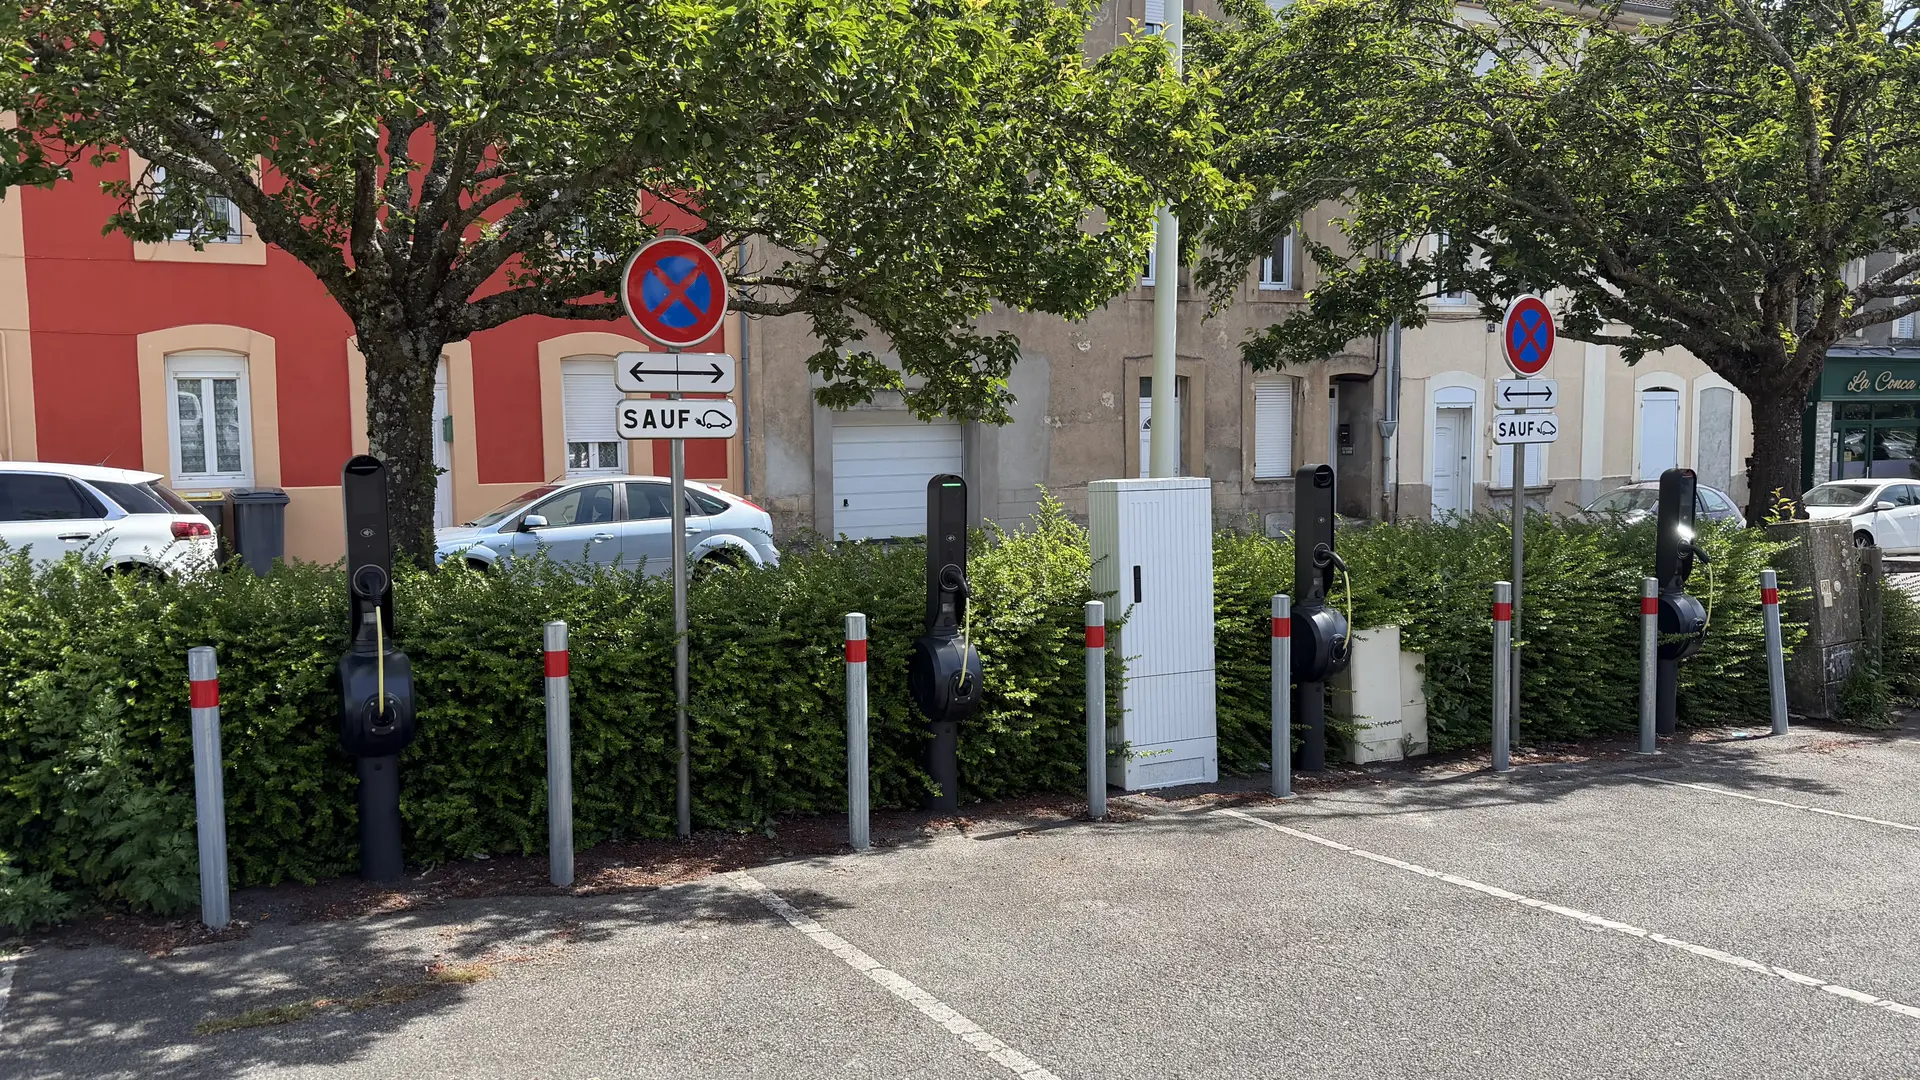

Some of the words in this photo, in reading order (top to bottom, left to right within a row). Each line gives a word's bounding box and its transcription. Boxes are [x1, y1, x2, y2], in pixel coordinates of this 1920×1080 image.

[1847, 369, 1871, 393] La
[1875, 370, 1917, 392] Conca
[623, 408, 691, 430] SAUF
[1499, 421, 1535, 437] SAUF
